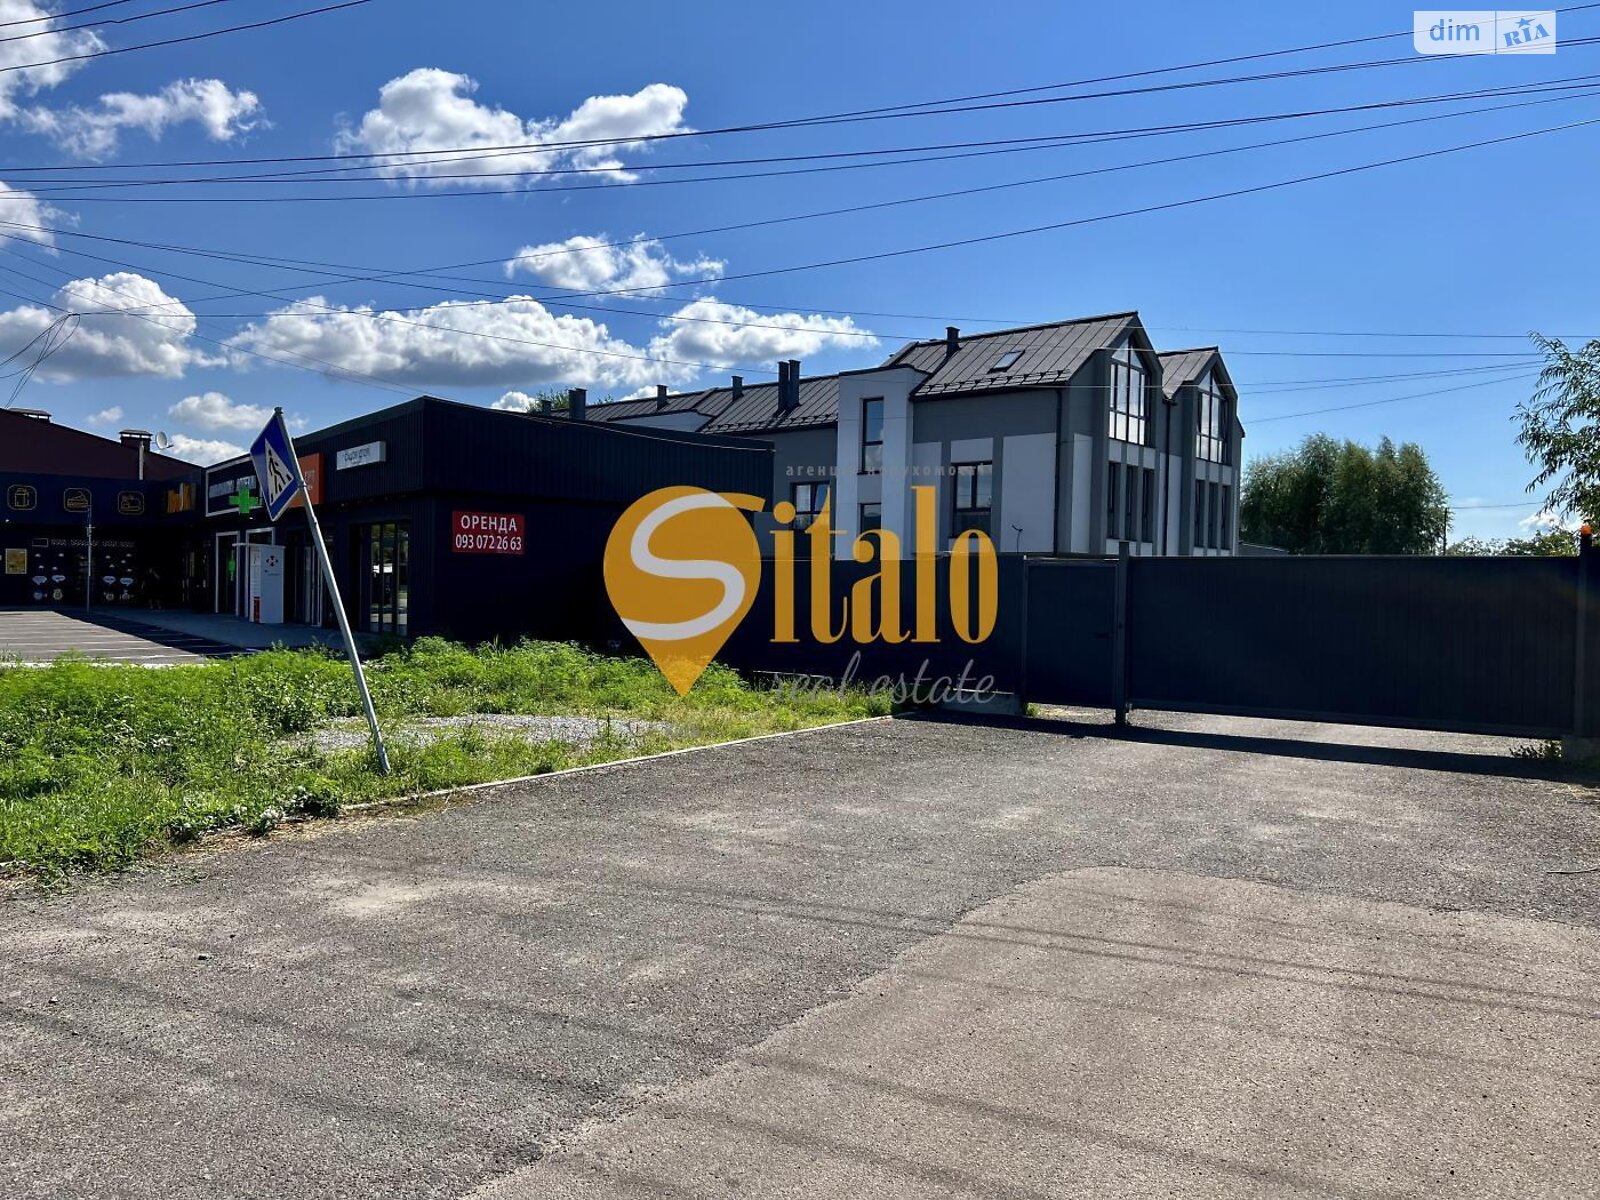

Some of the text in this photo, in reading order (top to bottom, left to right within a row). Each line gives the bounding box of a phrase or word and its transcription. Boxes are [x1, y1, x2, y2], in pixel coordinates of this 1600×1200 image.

[460, 515, 518, 534] ОРЕНДА
[455, 534, 522, 551] 093 072 26 63
